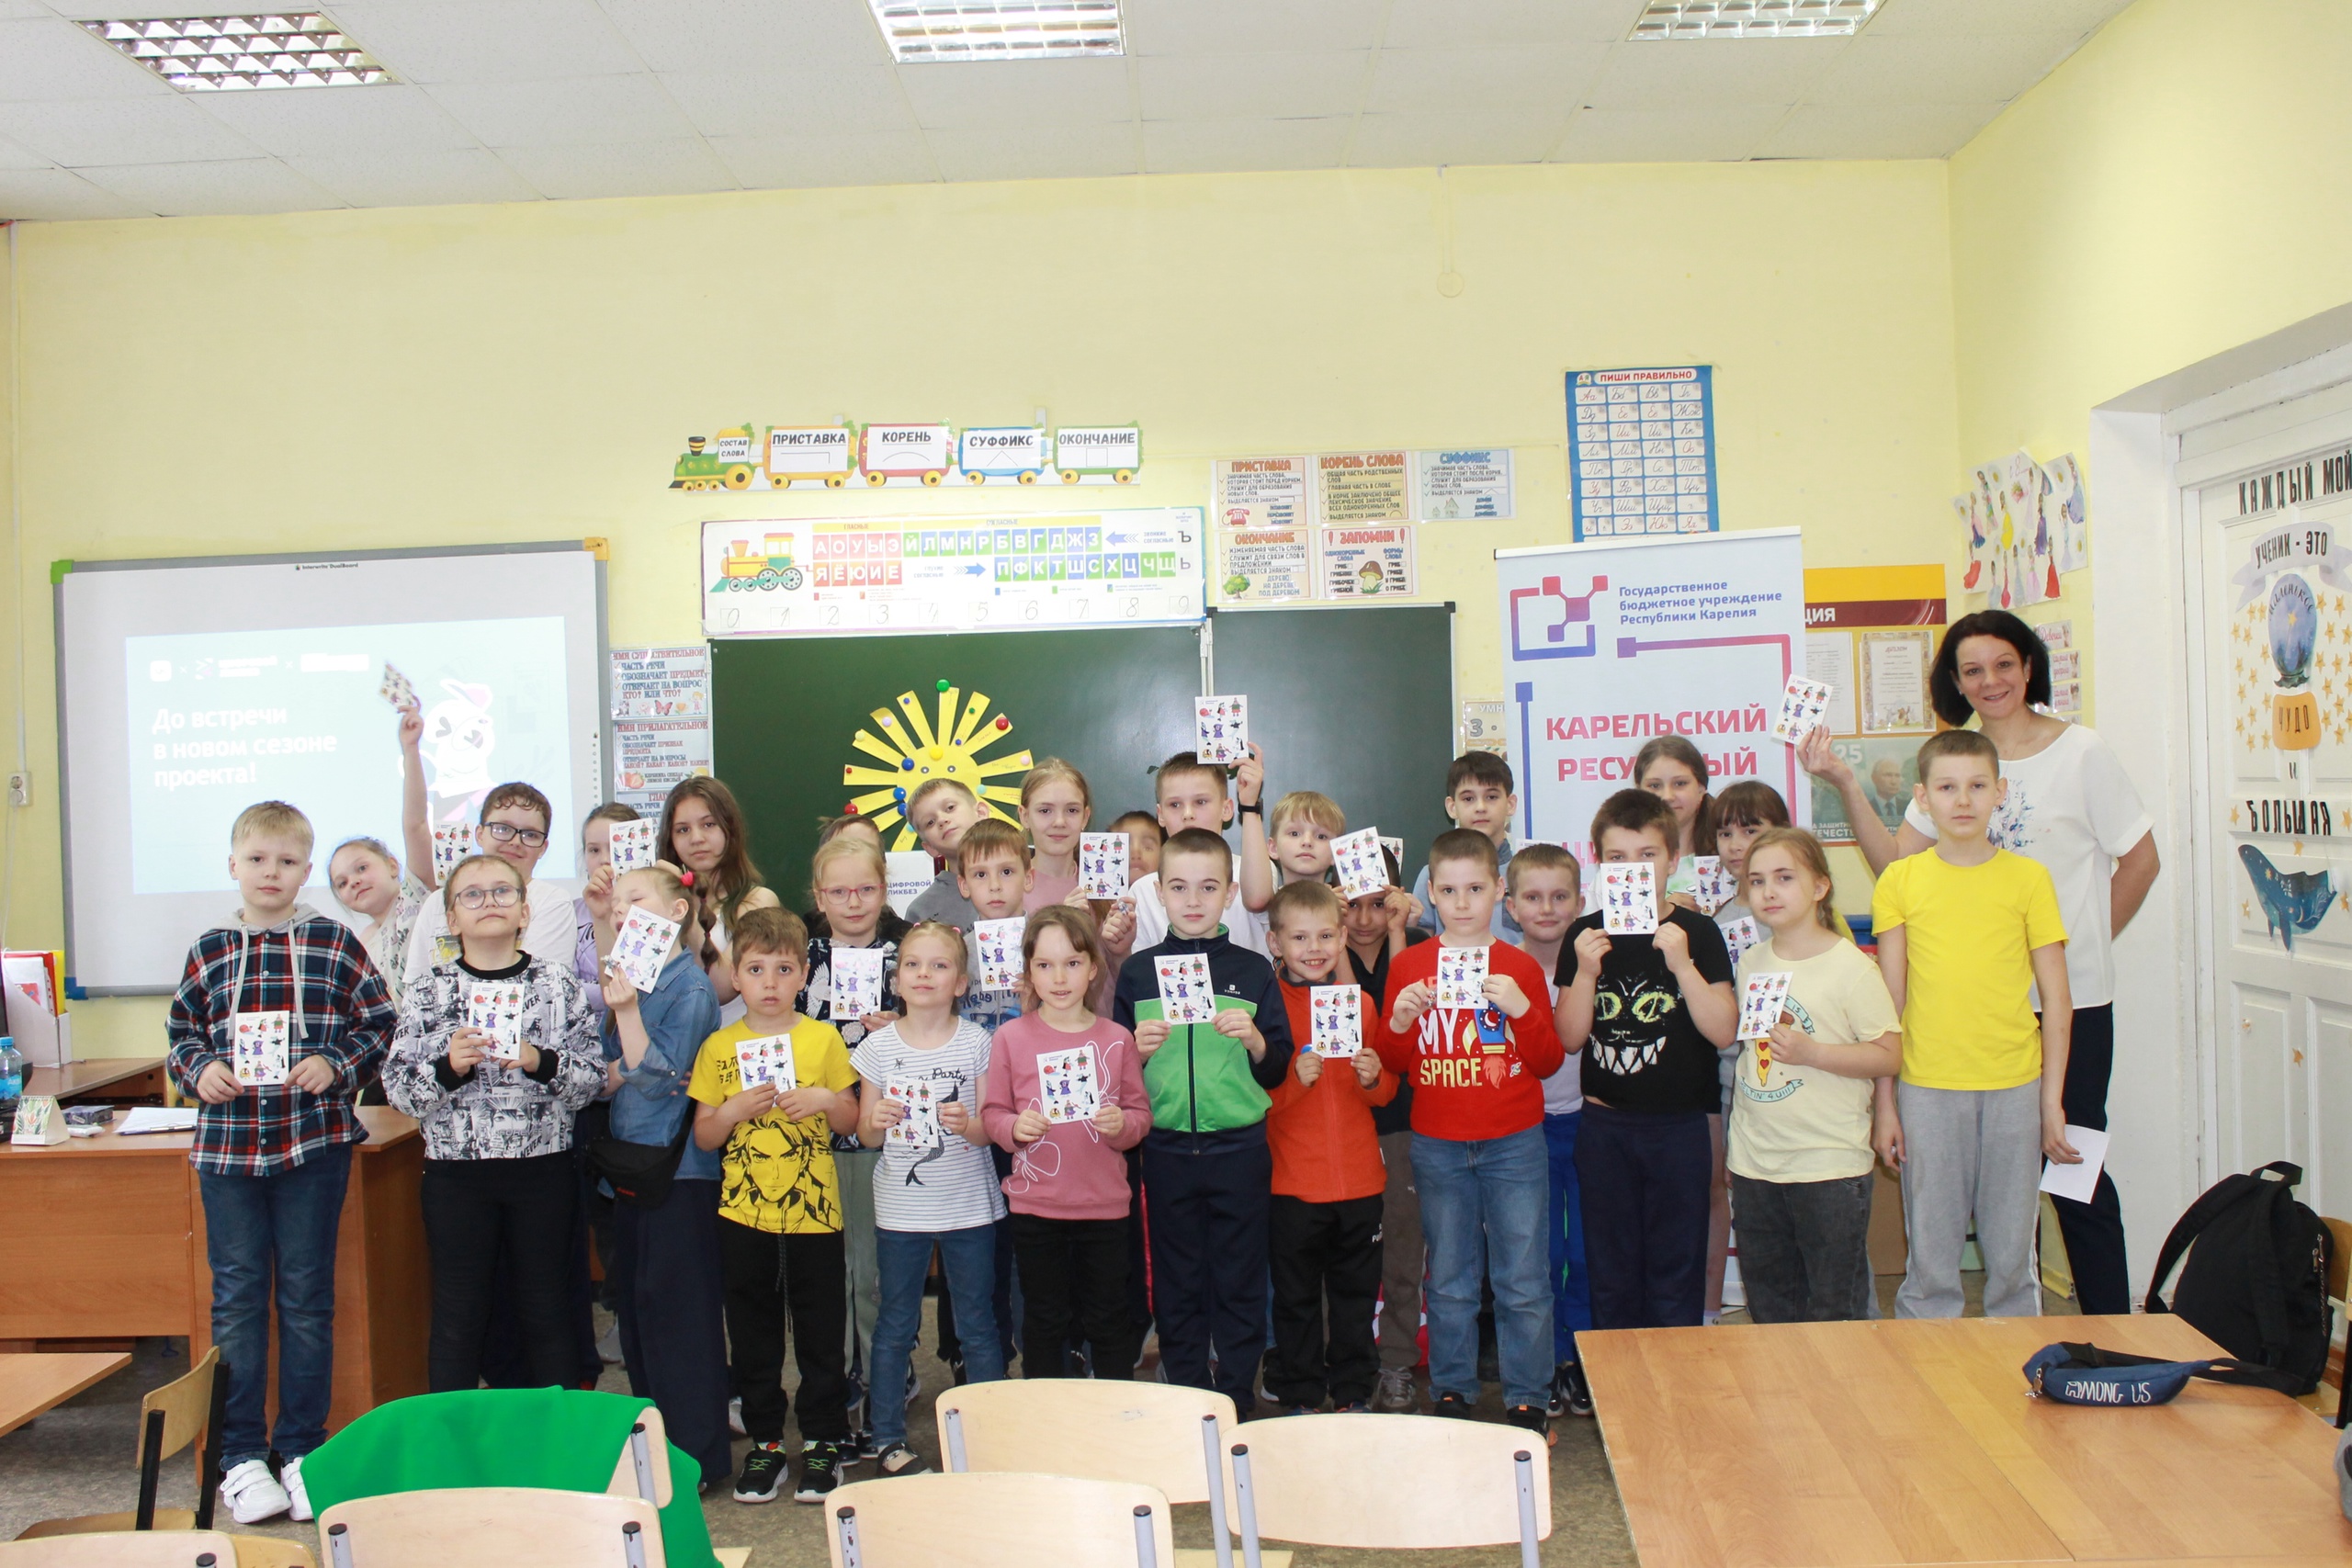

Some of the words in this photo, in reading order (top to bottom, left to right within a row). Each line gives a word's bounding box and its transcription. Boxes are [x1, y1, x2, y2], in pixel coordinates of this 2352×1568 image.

[1600, 373, 1630, 382] ПИШИ
[1634, 371, 1692, 380] ПРАВИЛЬНО
[720, 439, 747, 447] СОСТАВ
[773, 434, 846, 445] ПРИСТАВКА
[882, 431, 932, 443] КОРЕНЬ
[969, 434, 1034, 447] СУФФИКС
[1058, 433, 1136, 445] ОКОНЧАНИЕ
[1232, 460, 1291, 472] ПРИСТАВКА
[1320, 456, 1363, 469] КОРЕНЬ
[1366, 454, 1403, 467] СЛОВА
[1440, 452, 1491, 464] СУФФИКС
[2239, 461, 2313, 515] КАЖДЫЙ
[2323, 449, 2352, 495] МОЙ
[815, 541, 828, 554] А
[832, 541, 845, 553] О
[850, 540, 863, 552] У
[868, 539, 882, 551] Ы
[888, 538, 899, 551] Э
[906, 535, 917, 550] Й
[923, 537, 935, 551] Л
[942, 537, 954, 550] М
[960, 536, 971, 549] Н
[978, 536, 989, 548] Р
[997, 535, 1009, 548] Б
[1015, 535, 1027, 548] В
[1035, 534, 1044, 547] Г
[1051, 534, 1063, 549] Д
[1068, 534, 1083, 547] Ж
[1089, 533, 1099, 546] З
[1178, 531, 1192, 543] Ъ
[1235, 532, 1295, 545] ОКОНЧАНИЕ
[1340, 530, 1395, 544] ЗАПОМНИ
[2256, 533, 2290, 570] УЧЕНИК
[2306, 531, 2327, 557] ЭТО
[816, 568, 827, 581] Я
[834, 564, 844, 580] Ё
[850, 566, 865, 580] Ю
[870, 566, 881, 579] И
[889, 566, 899, 579] Е
[998, 561, 1008, 575] П
[1013, 561, 1027, 575] Ф
[1035, 560, 1044, 574] К
[1051, 560, 1061, 573] Т
[1069, 559, 1083, 572] Ш
[1088, 559, 1100, 573] С
[1107, 558, 1118, 572] Х
[1125, 558, 1136, 574] Ц
[1144, 558, 1154, 570] Ч
[1159, 558, 1175, 572] Щ
[1619, 581, 1728, 597] Государственное
[1619, 598, 1695, 612] бюджетное
[1699, 591, 1782, 608] учреждение
[1620, 610, 1697, 626] Республики
[1700, 607, 1757, 620] Карелия
[622, 671, 668, 681] ОБОЗНАЧАЕТ
[622, 682, 660, 691] ОТВЕЧАЕТ
[673, 680, 702, 688] ВОПРОС
[623, 691, 641, 699] КТО?
[662, 689, 681, 697] ЧТО?
[152, 708, 185, 735] До
[192, 707, 288, 731] встречи
[617, 724, 635, 732] ИМЯ
[638, 721, 707, 731] ПРИЛАГАТЕЛЬНОЕ
[1546, 703, 1767, 741] КАРЕЛЬСКИЙ
[2279, 705, 2309, 733] ЧУДО
[154, 742, 167, 760] в
[174, 739, 247, 759] новом
[253, 735, 337, 755] сезоне
[154, 761, 257, 792] проекта!
[2246, 799, 2332, 836] БОЛЬШАЯ
[888, 880, 932, 888] ЦИФРОВОЙ
[1419, 1009, 1459, 1055] MY
[933, 1067, 967, 1086] Party
[1419, 1057, 1482, 1088] SPACE
[2132, 1382, 2151, 1403] US
